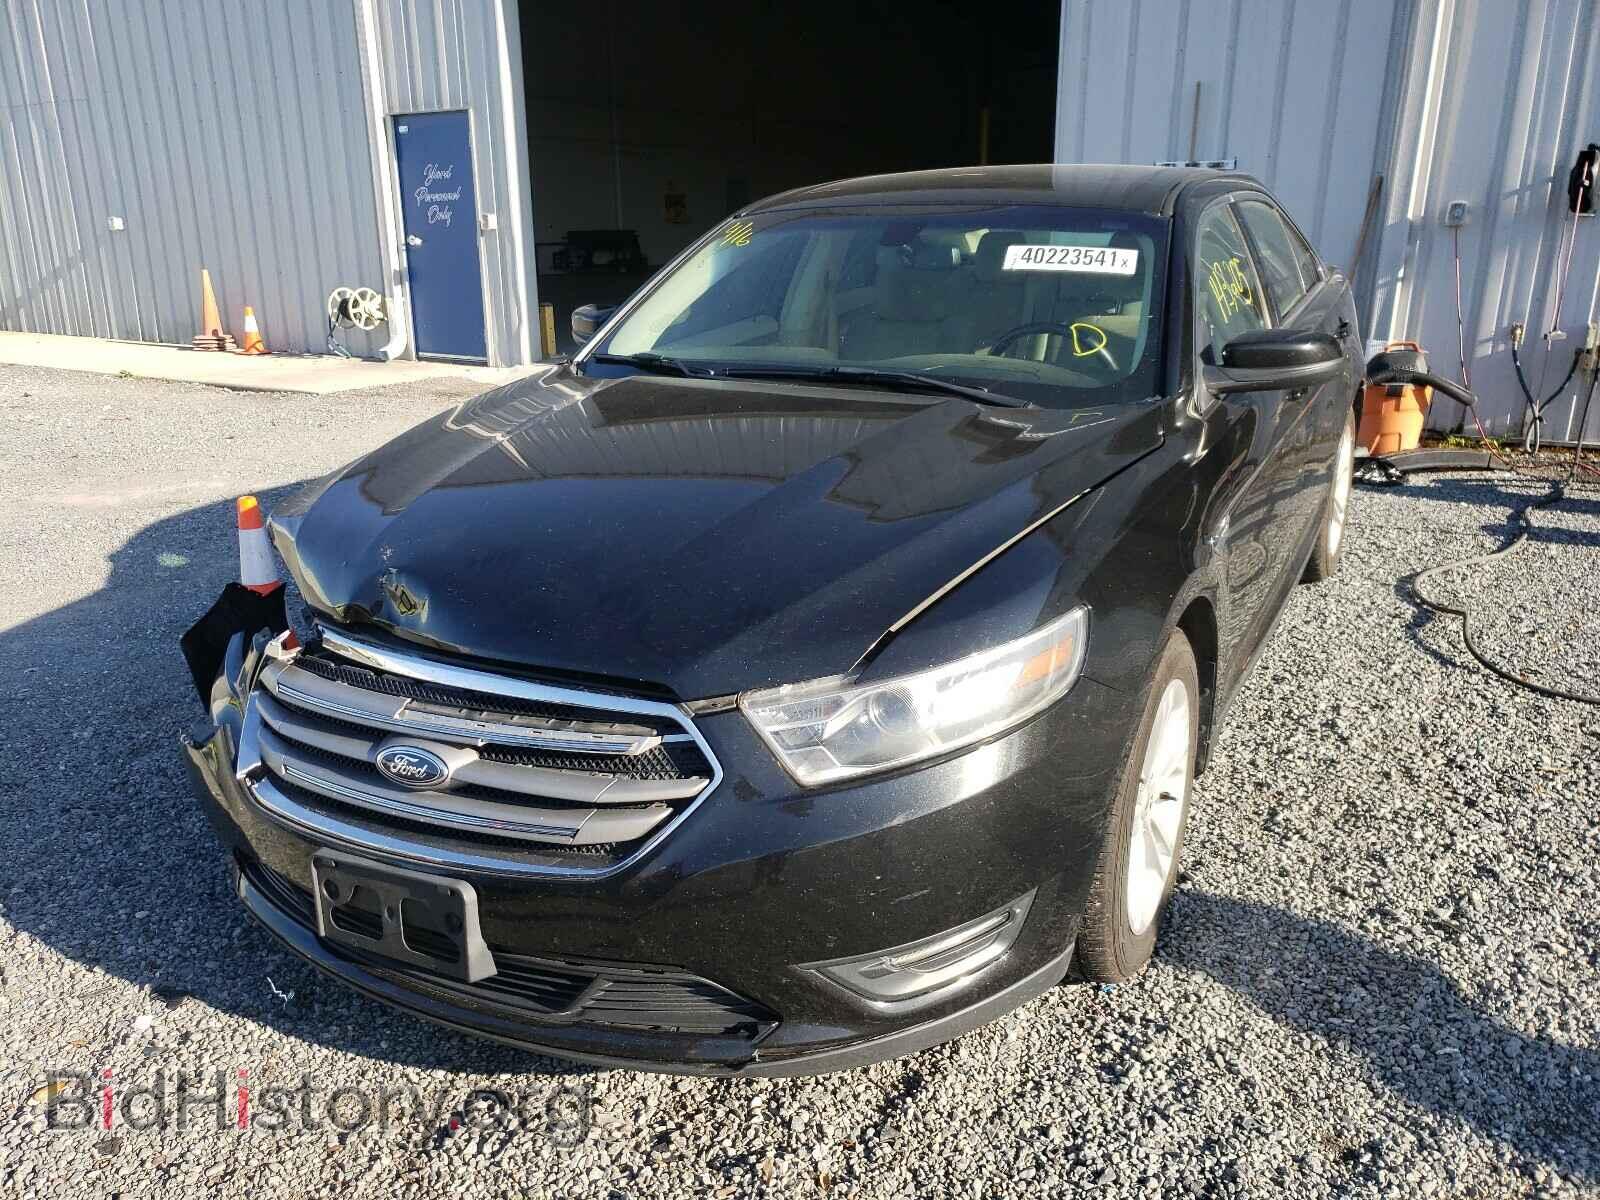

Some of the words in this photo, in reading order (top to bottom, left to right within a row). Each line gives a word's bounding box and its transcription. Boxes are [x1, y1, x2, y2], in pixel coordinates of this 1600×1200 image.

[424, 163, 454, 187] Yard
[428, 205, 453, 227] Only
[1021, 247, 1117, 267] 40223541
[1069, 322, 1107, 357] D
[390, 754, 429, 778] Ford
